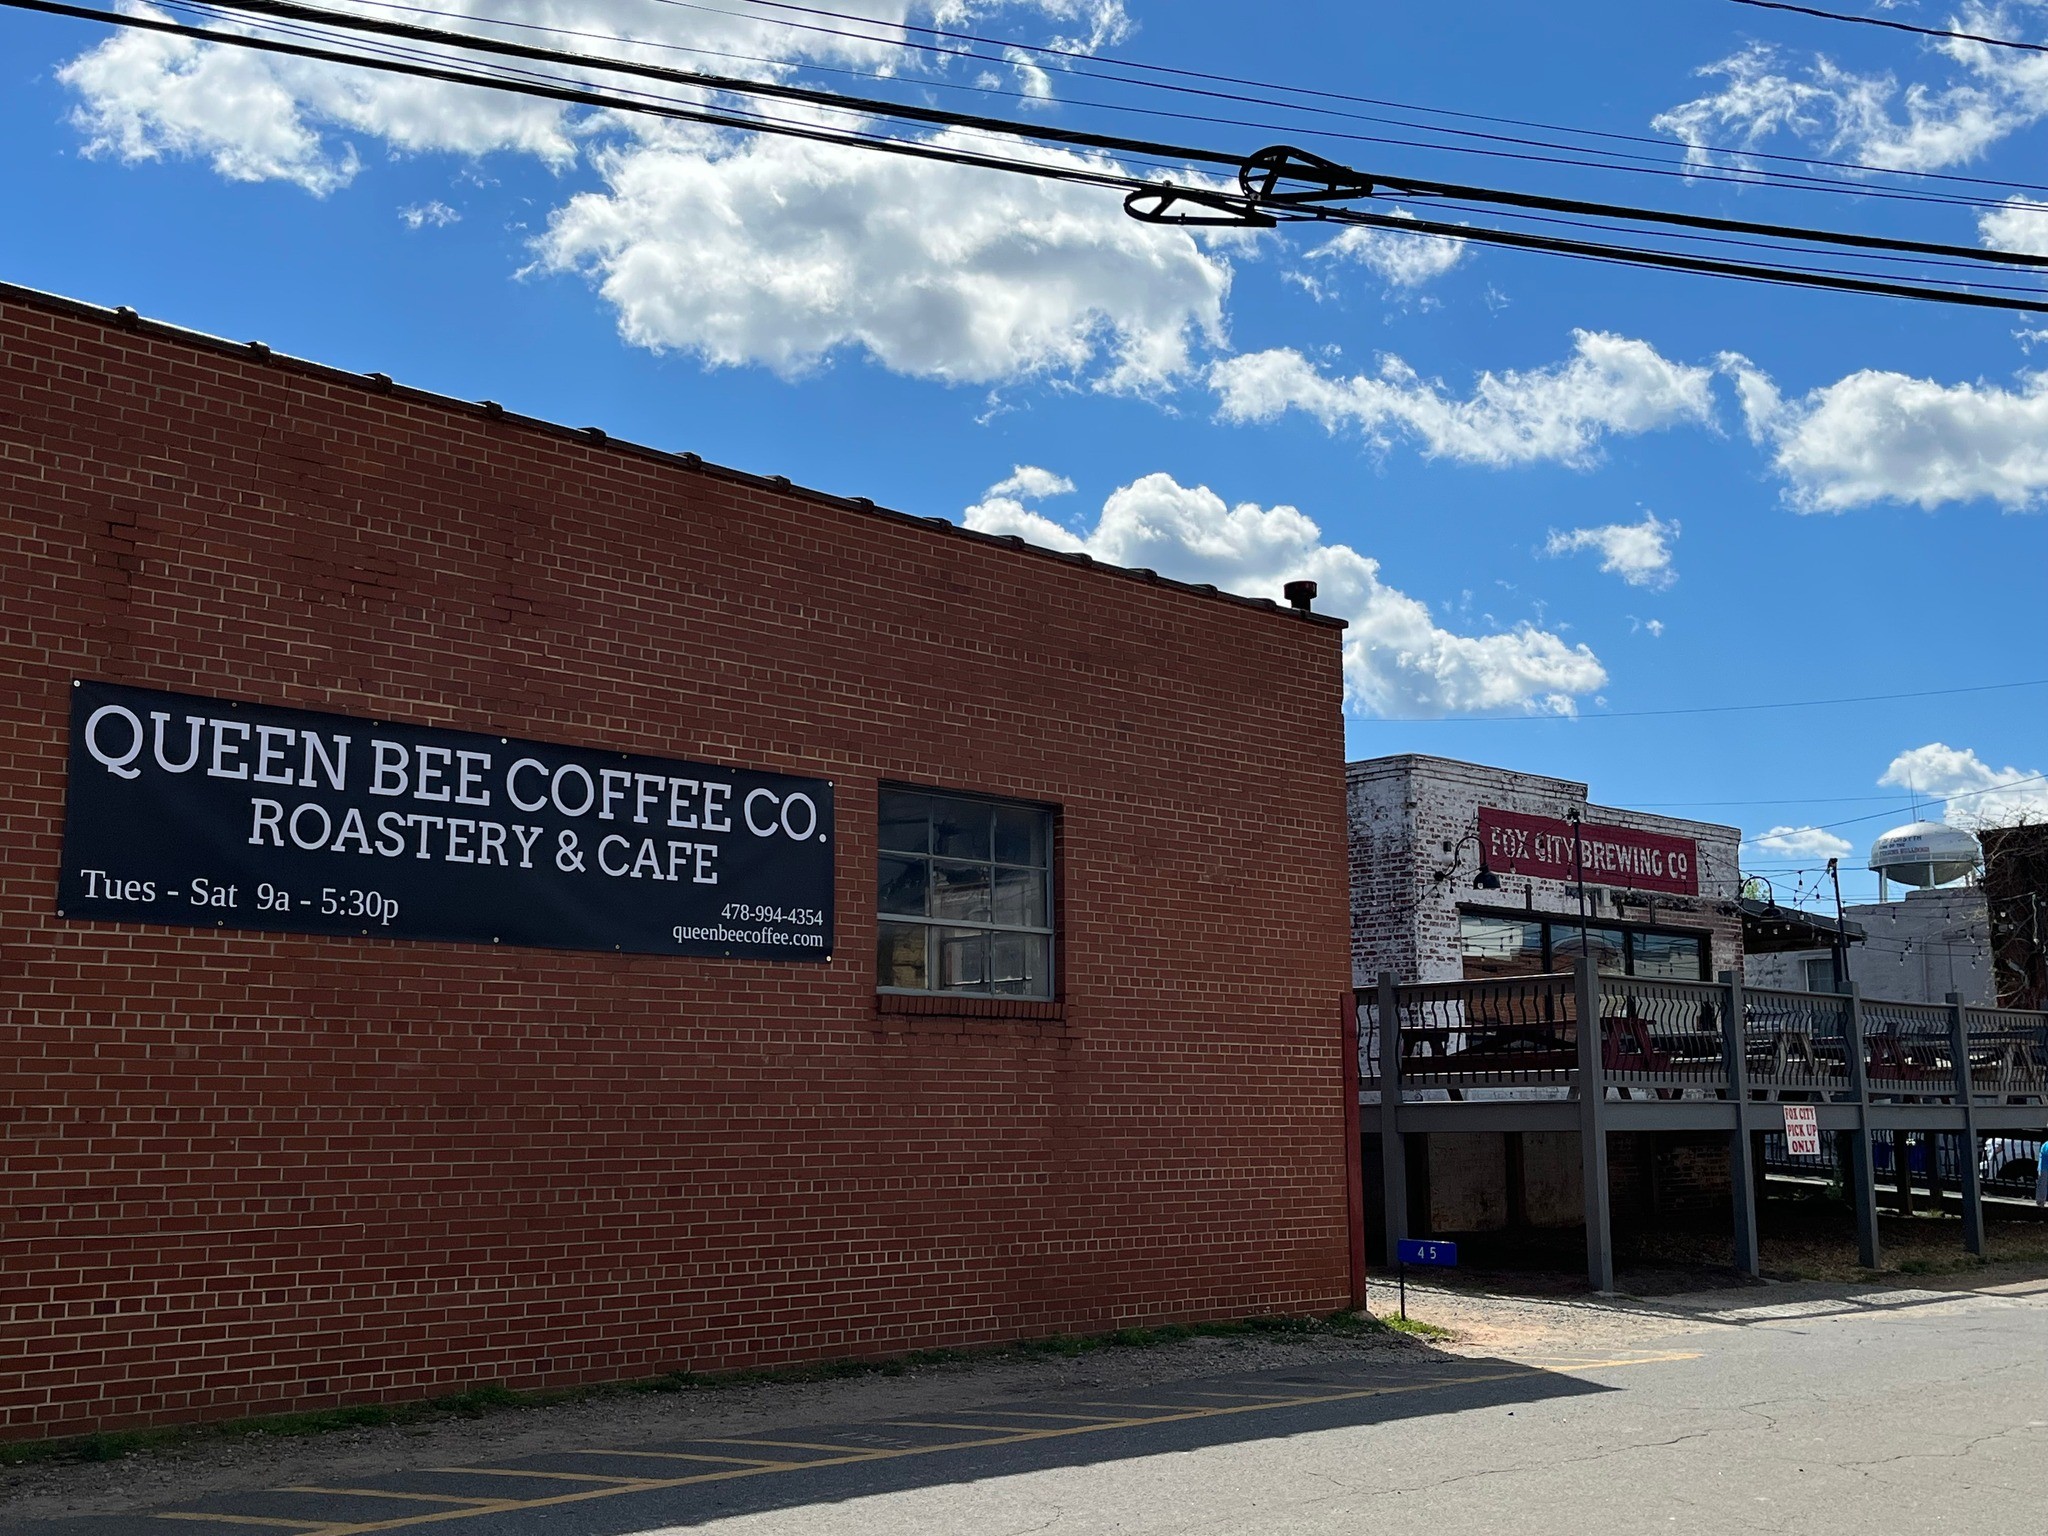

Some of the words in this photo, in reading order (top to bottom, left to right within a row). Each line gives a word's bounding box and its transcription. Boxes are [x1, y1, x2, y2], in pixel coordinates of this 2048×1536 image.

[85, 705, 351, 790] QUEEN
[369, 740, 491, 806] BEE
[507, 758, 731, 832] COFFEE
[744, 788, 826, 842] CO.
[249, 798, 543, 868] ROASTERY
[556, 830, 586, 872] &
[598, 835, 717, 884] CAFE
[1490, 826, 1530, 859] FOX
[1534, 831, 1576, 866] CITY
[1580, 839, 1663, 877] BREWING
[81, 870, 155, 901] Tues
[191, 878, 238, 907] Sat
[257, 883, 290, 911] 9a
[322, 888, 398, 925] 5:30p
[721, 904, 823, 925] 478-994-4354
[673, 924, 823, 947] queenbeecoffee.com
[1785, 1108, 1798, 1120] FOX
[1799, 1108, 1815, 1120] CITY
[1787, 1124, 1806, 1137] PICK
[1806, 1124, 1817, 1137] UP
[1792, 1140, 1816, 1153] ONLY
[1417, 1246, 1437, 1260] 45
